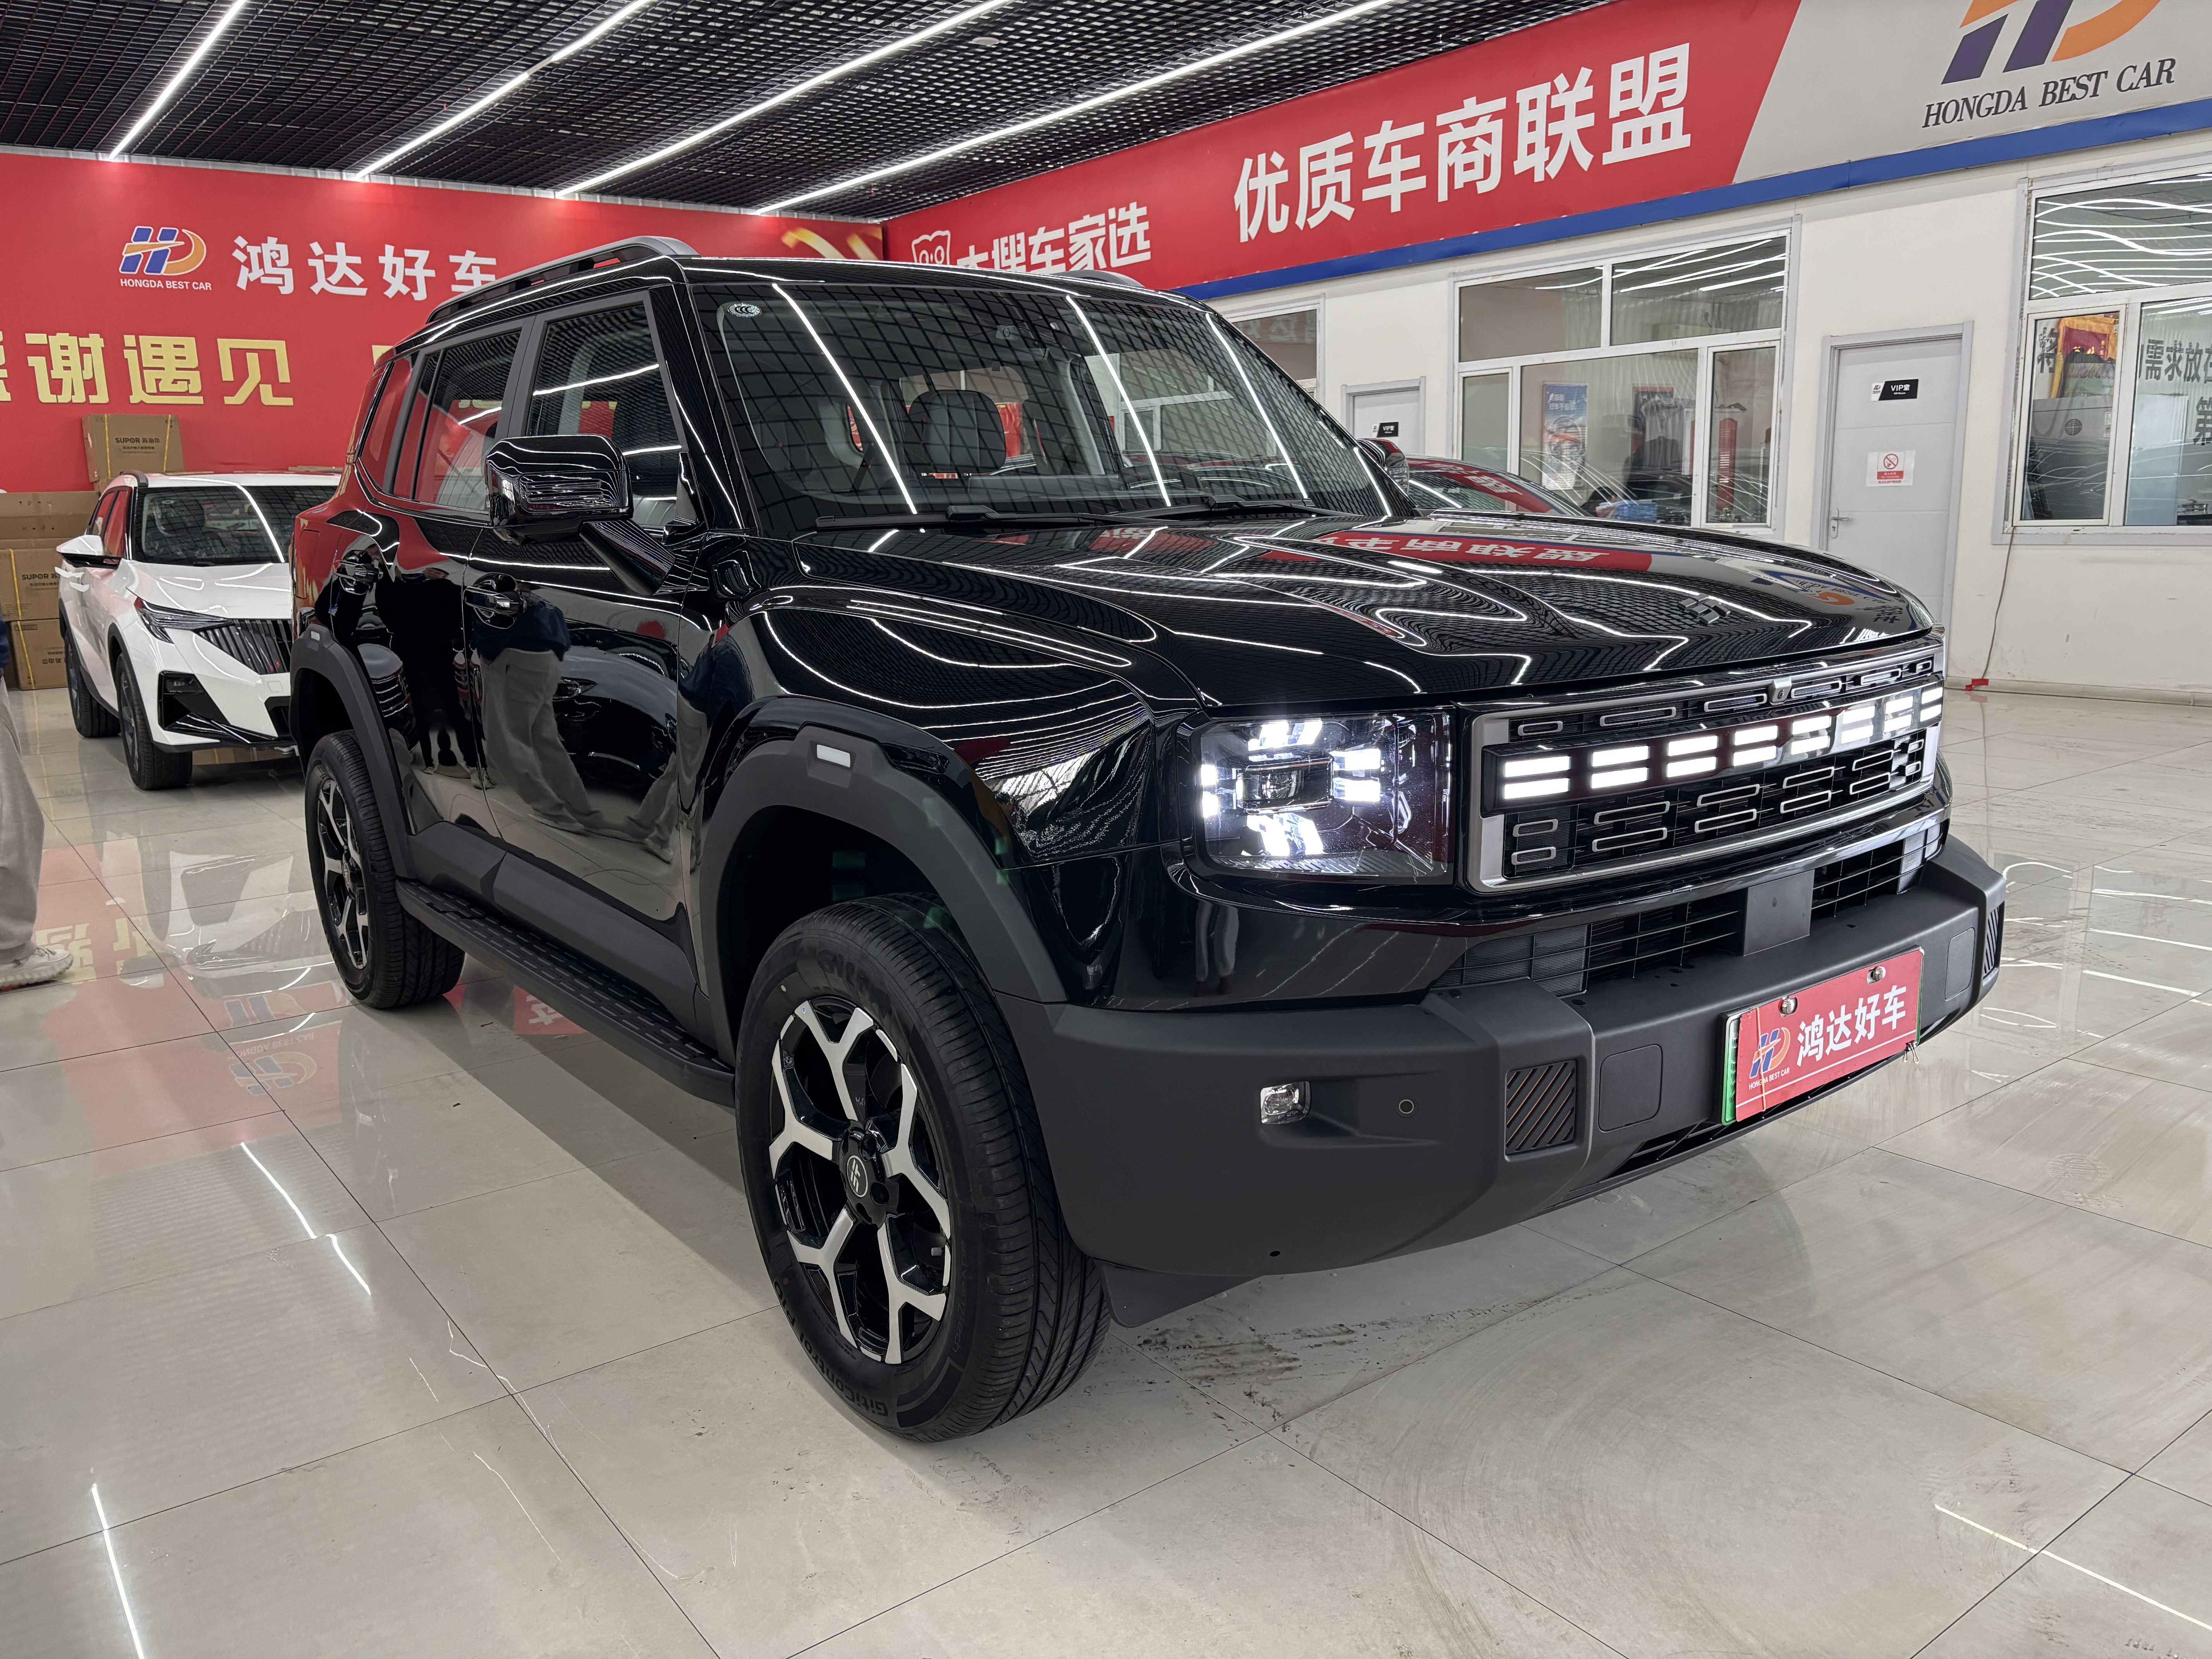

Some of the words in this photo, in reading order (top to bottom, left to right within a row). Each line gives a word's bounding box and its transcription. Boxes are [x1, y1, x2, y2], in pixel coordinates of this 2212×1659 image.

[1922, 86, 2028, 128] HONGDA
[2039, 70, 2109, 107] BEST
[2116, 58, 2176, 93] CAR
[1234, 43, 1691, 242] 优质车商联盟
[120, 278, 163, 290] HONGDA
[165, 280, 190, 290] BEST
[192, 282, 212, 291] CAR
[232, 235, 497, 301] 鸿达好车
[0, 330, 294, 406] 谢遇见
[1796, 985, 1906, 1067] 鸿达好车
[1769, 1071, 1780, 1082] BEST
[1781, 1067, 1790, 1076] CAR
